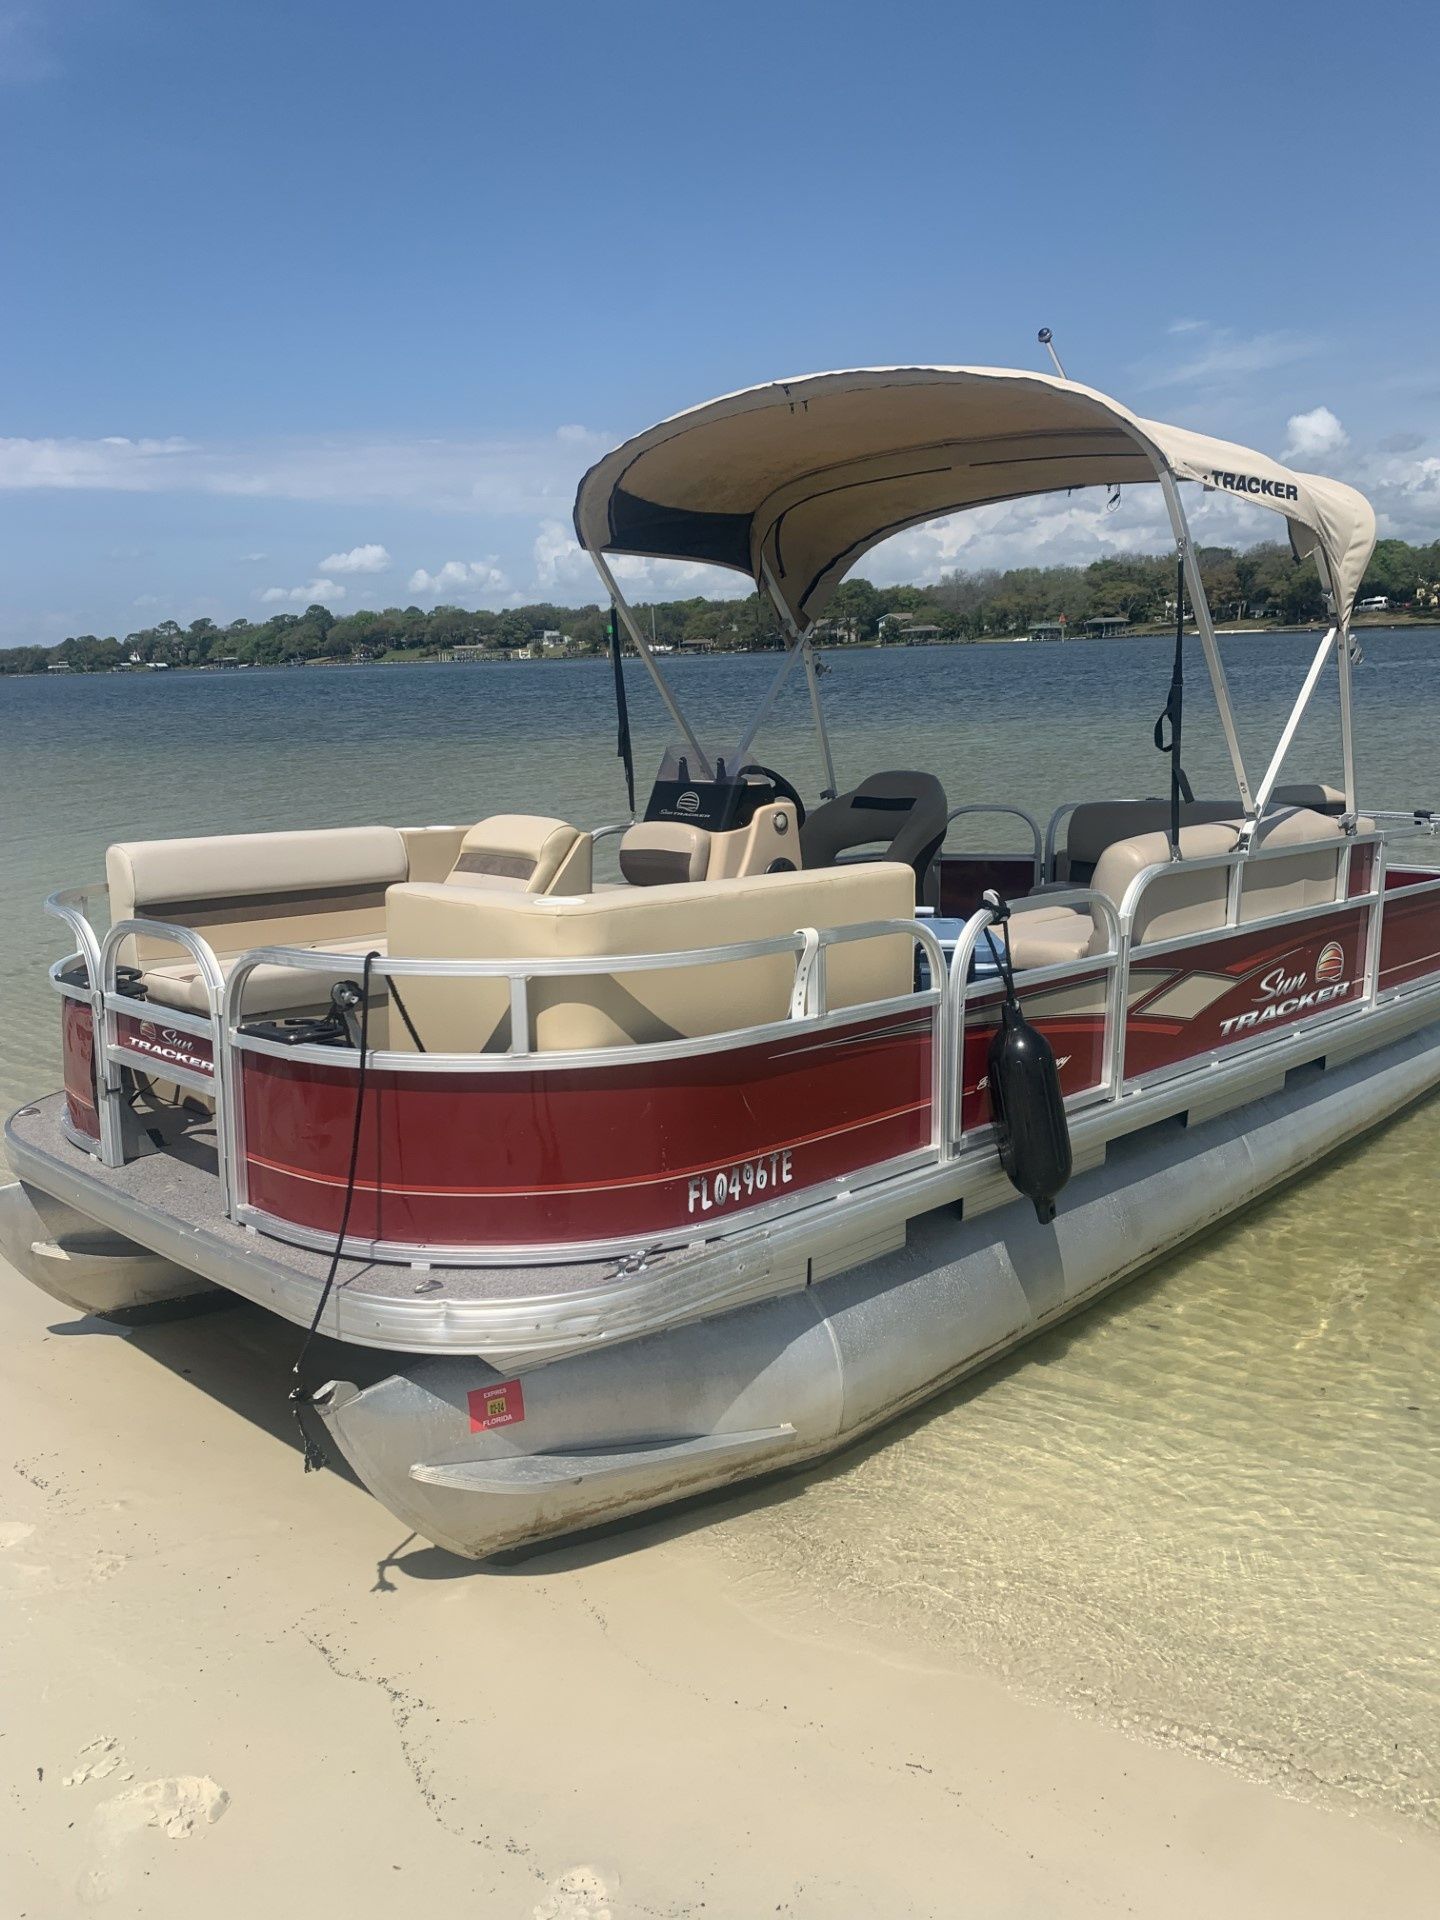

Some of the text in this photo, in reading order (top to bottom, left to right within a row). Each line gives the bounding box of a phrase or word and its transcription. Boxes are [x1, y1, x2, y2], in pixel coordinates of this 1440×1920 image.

[1211, 469, 1299, 501] TRACKER
[1251, 966, 1308, 1004] Sun
[1219, 980, 1351, 1038] TRACKER
[128, 1036, 215, 1072] TRACKER
[160, 1029, 195, 1053] Sun
[483, 1387, 507, 1399] EXPIRES
[482, 1414, 513, 1427] FLORIDA
